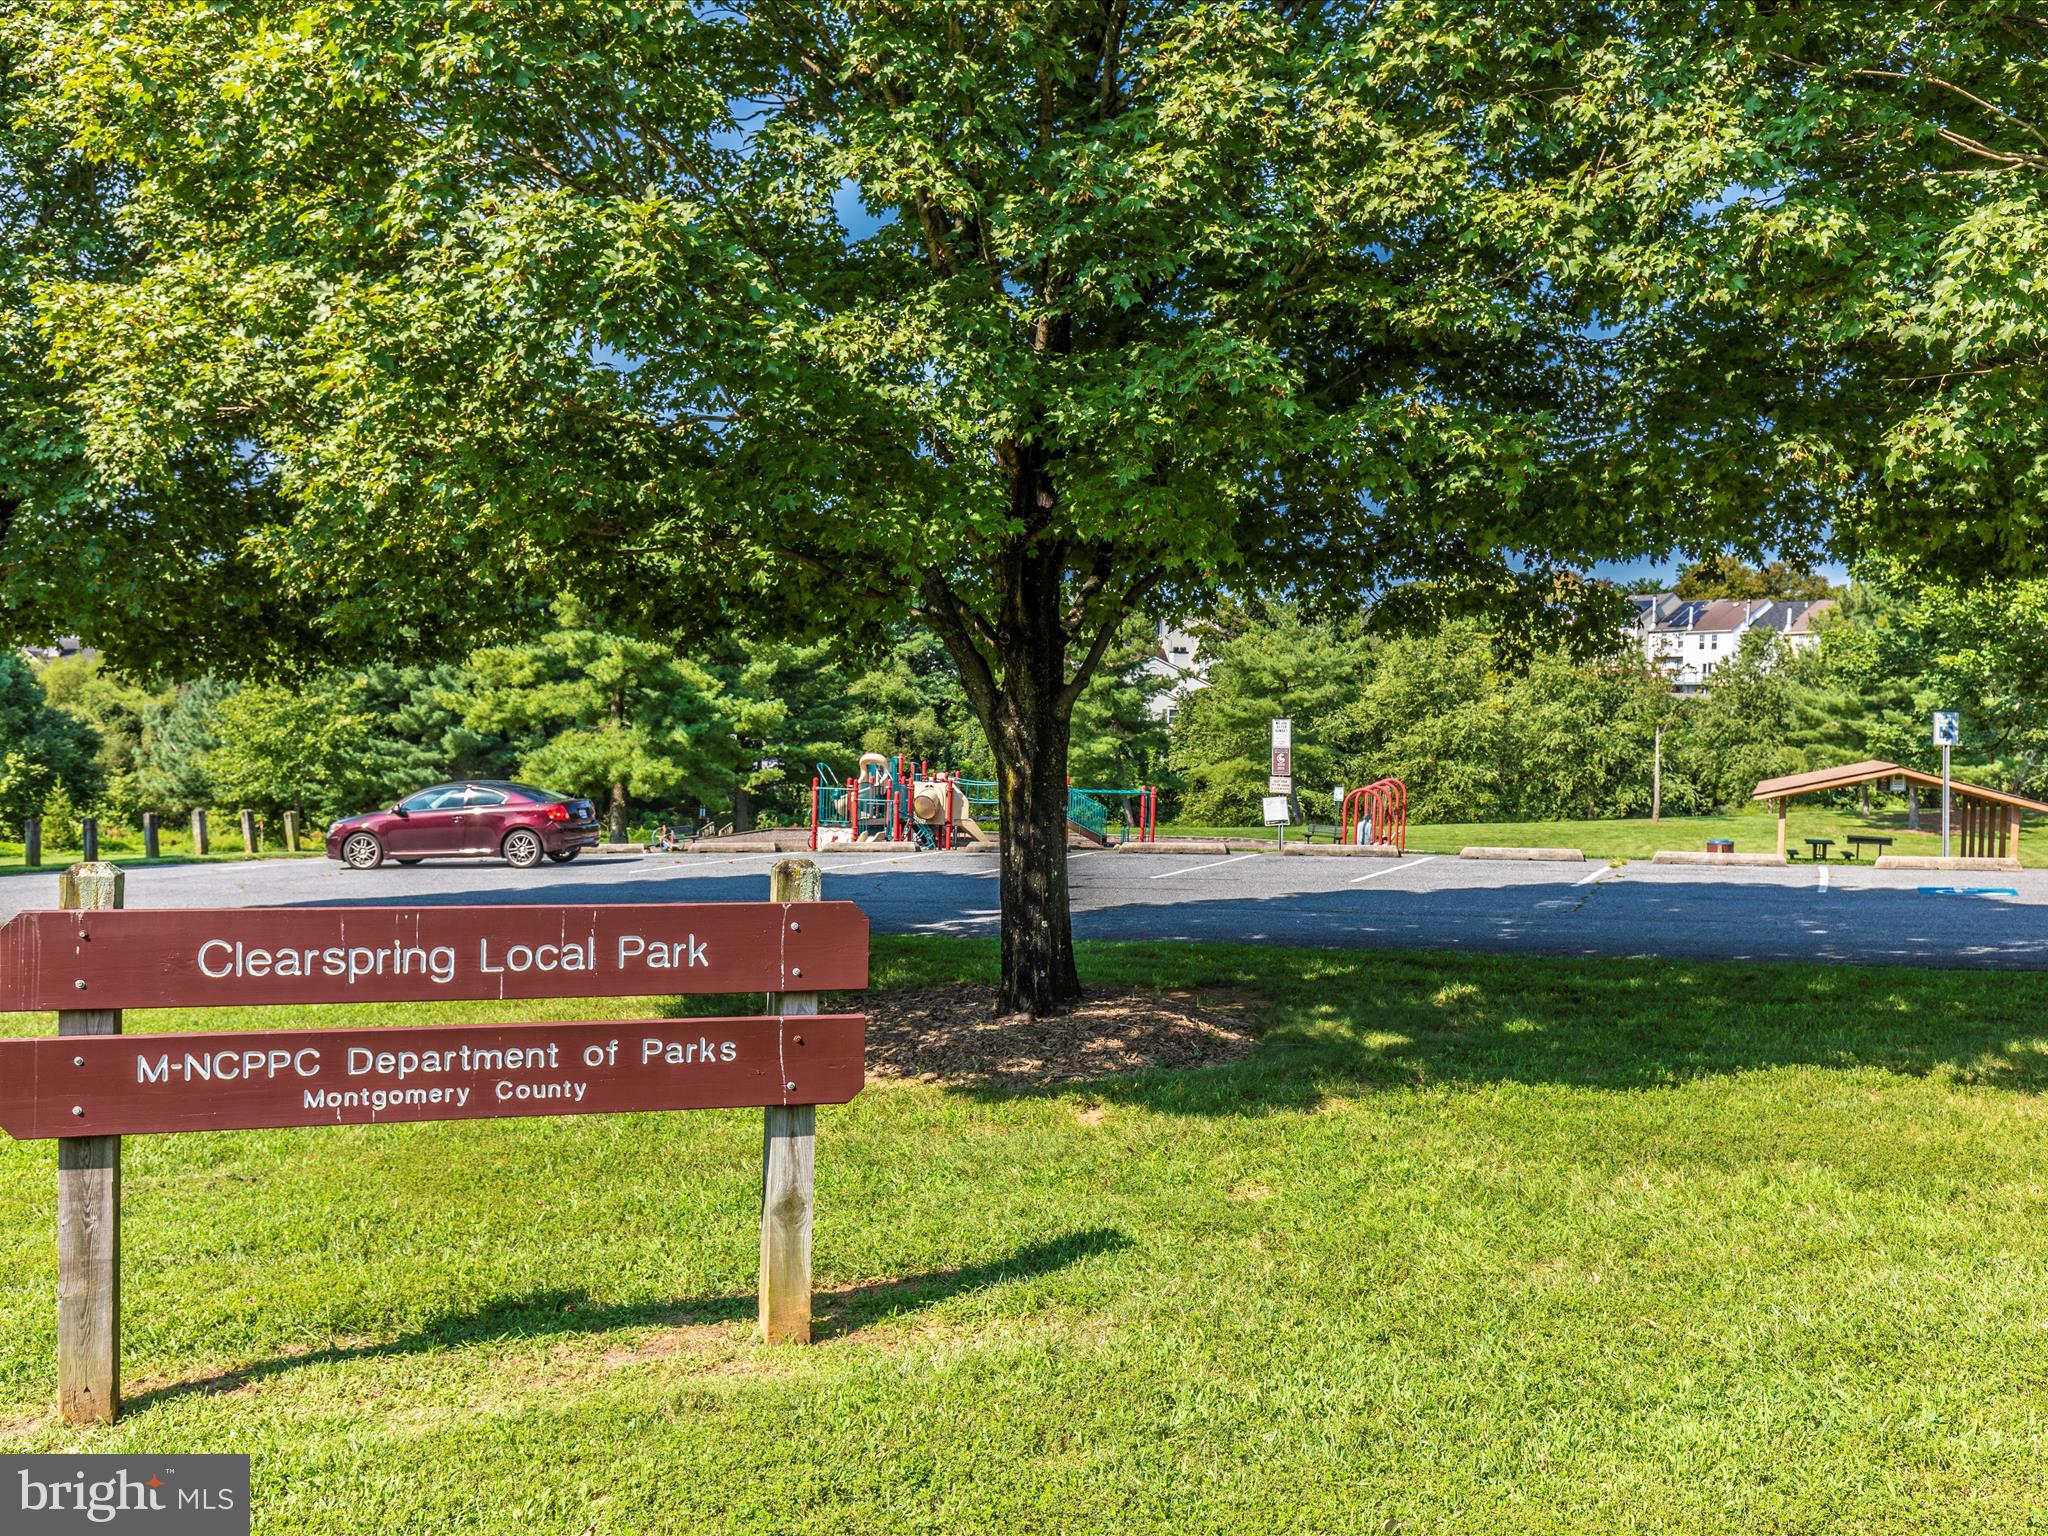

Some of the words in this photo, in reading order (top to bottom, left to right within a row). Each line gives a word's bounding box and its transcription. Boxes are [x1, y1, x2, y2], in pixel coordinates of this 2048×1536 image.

[197, 939, 456, 984] Clearspring
[480, 936, 594, 972] Local
[618, 933, 709, 969] Park
[137, 1047, 321, 1083] M-NCPPC
[347, 1043, 560, 1080] Department
[583, 1039, 619, 1067] of
[641, 1037, 738, 1065] Parks
[303, 1087, 470, 1111] Montgomery
[495, 1080, 588, 1102] County
